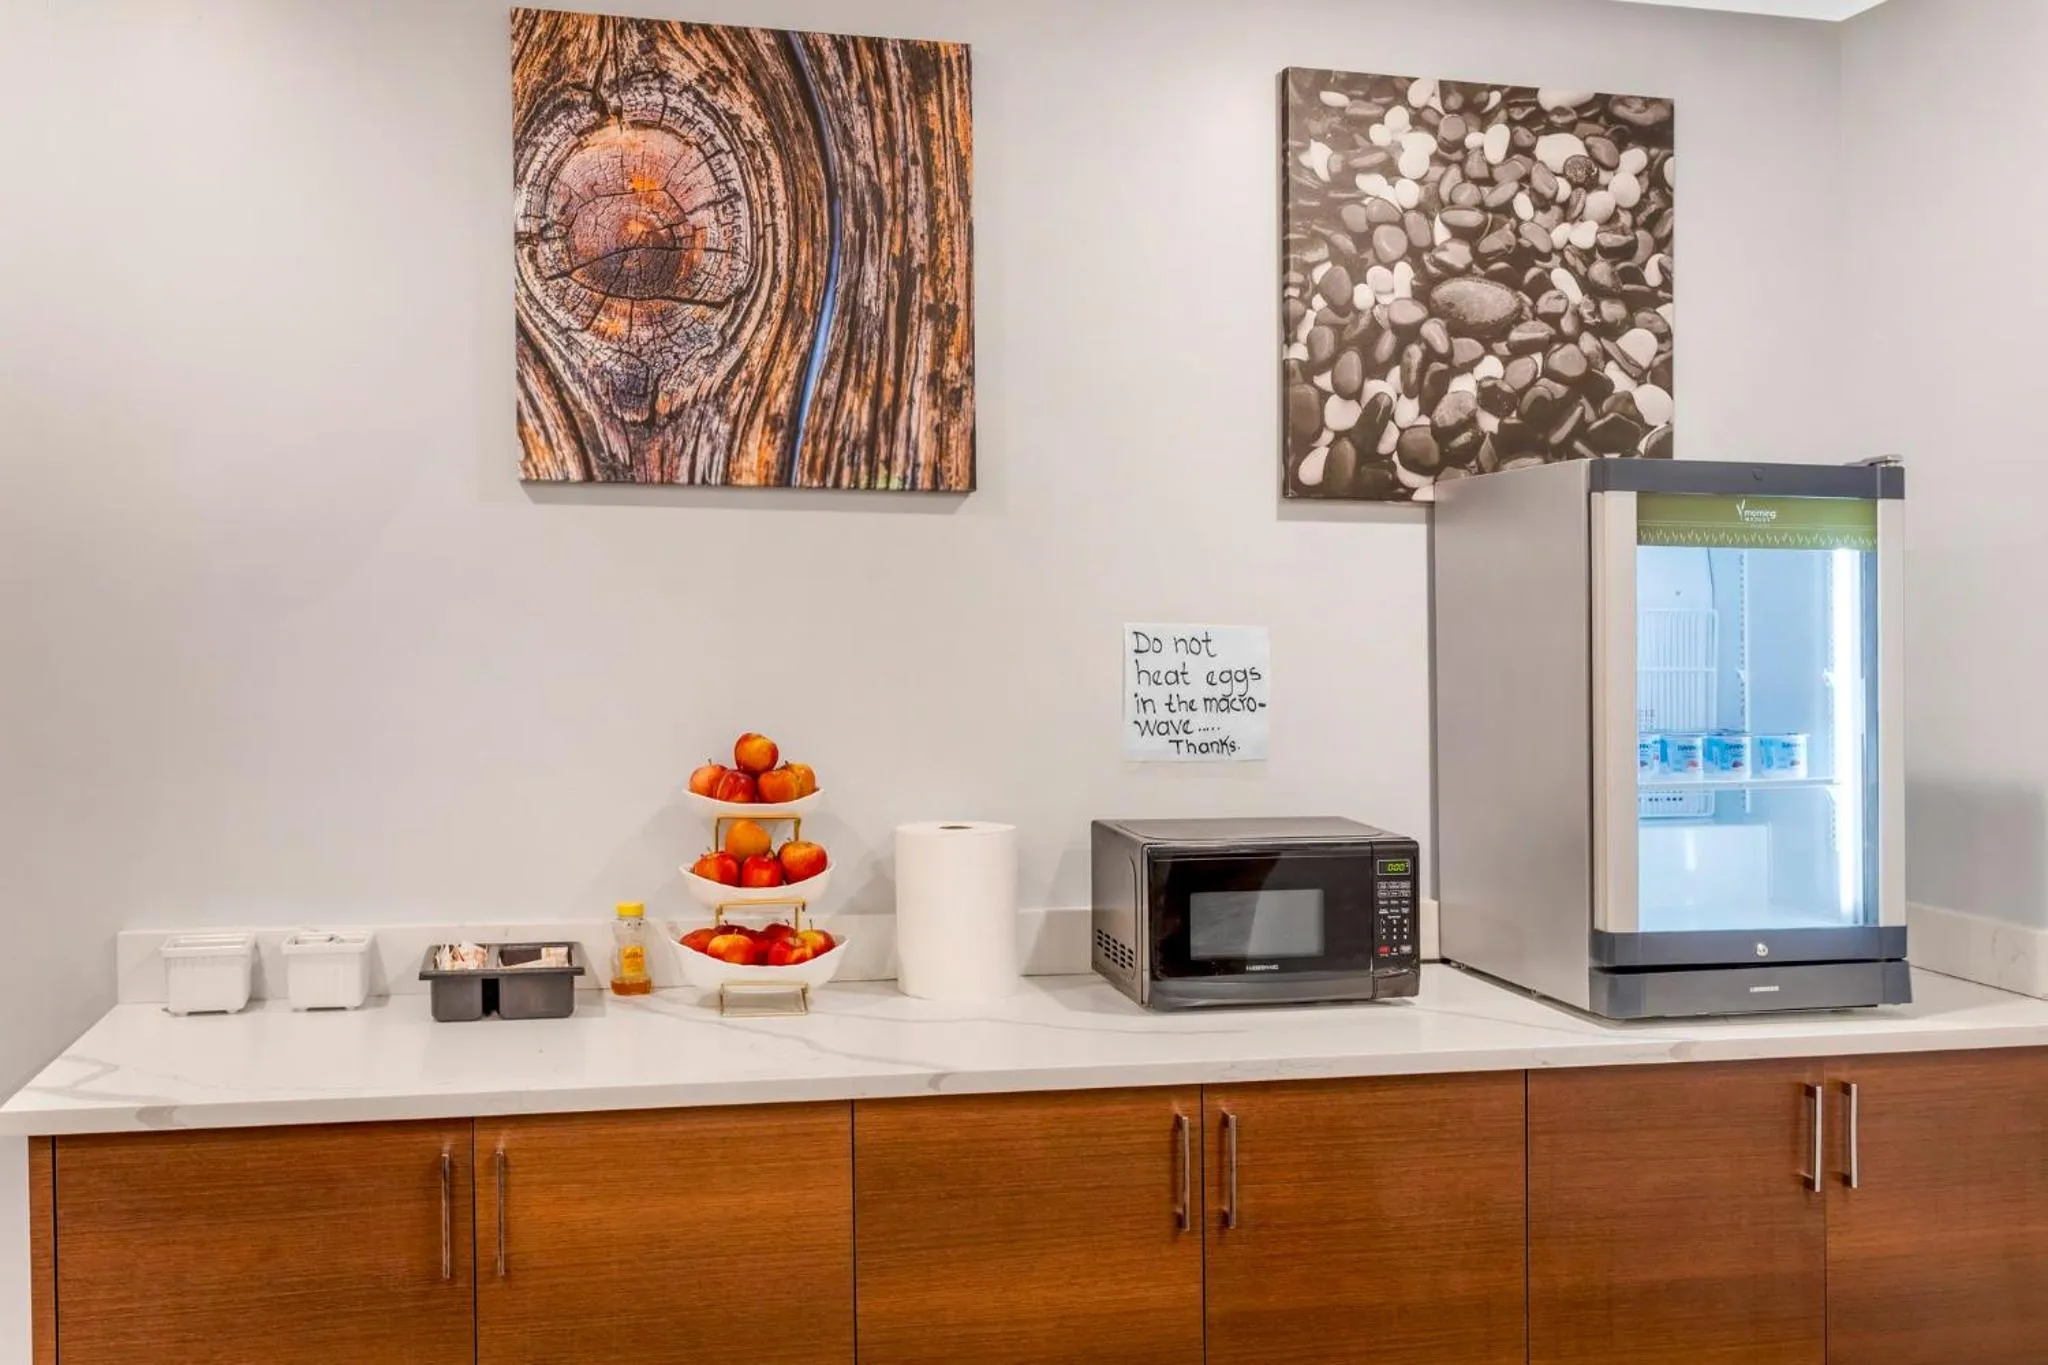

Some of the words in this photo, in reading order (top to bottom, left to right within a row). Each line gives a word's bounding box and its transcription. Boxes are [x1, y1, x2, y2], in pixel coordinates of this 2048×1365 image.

[1132, 631, 1163, 654] Do
[1173, 631, 1217, 658] not
[1134, 659, 1191, 687] heat
[1206, 667, 1262, 697] eggs
[1134, 692, 1156, 714] in
[1164, 693, 1198, 713] the
